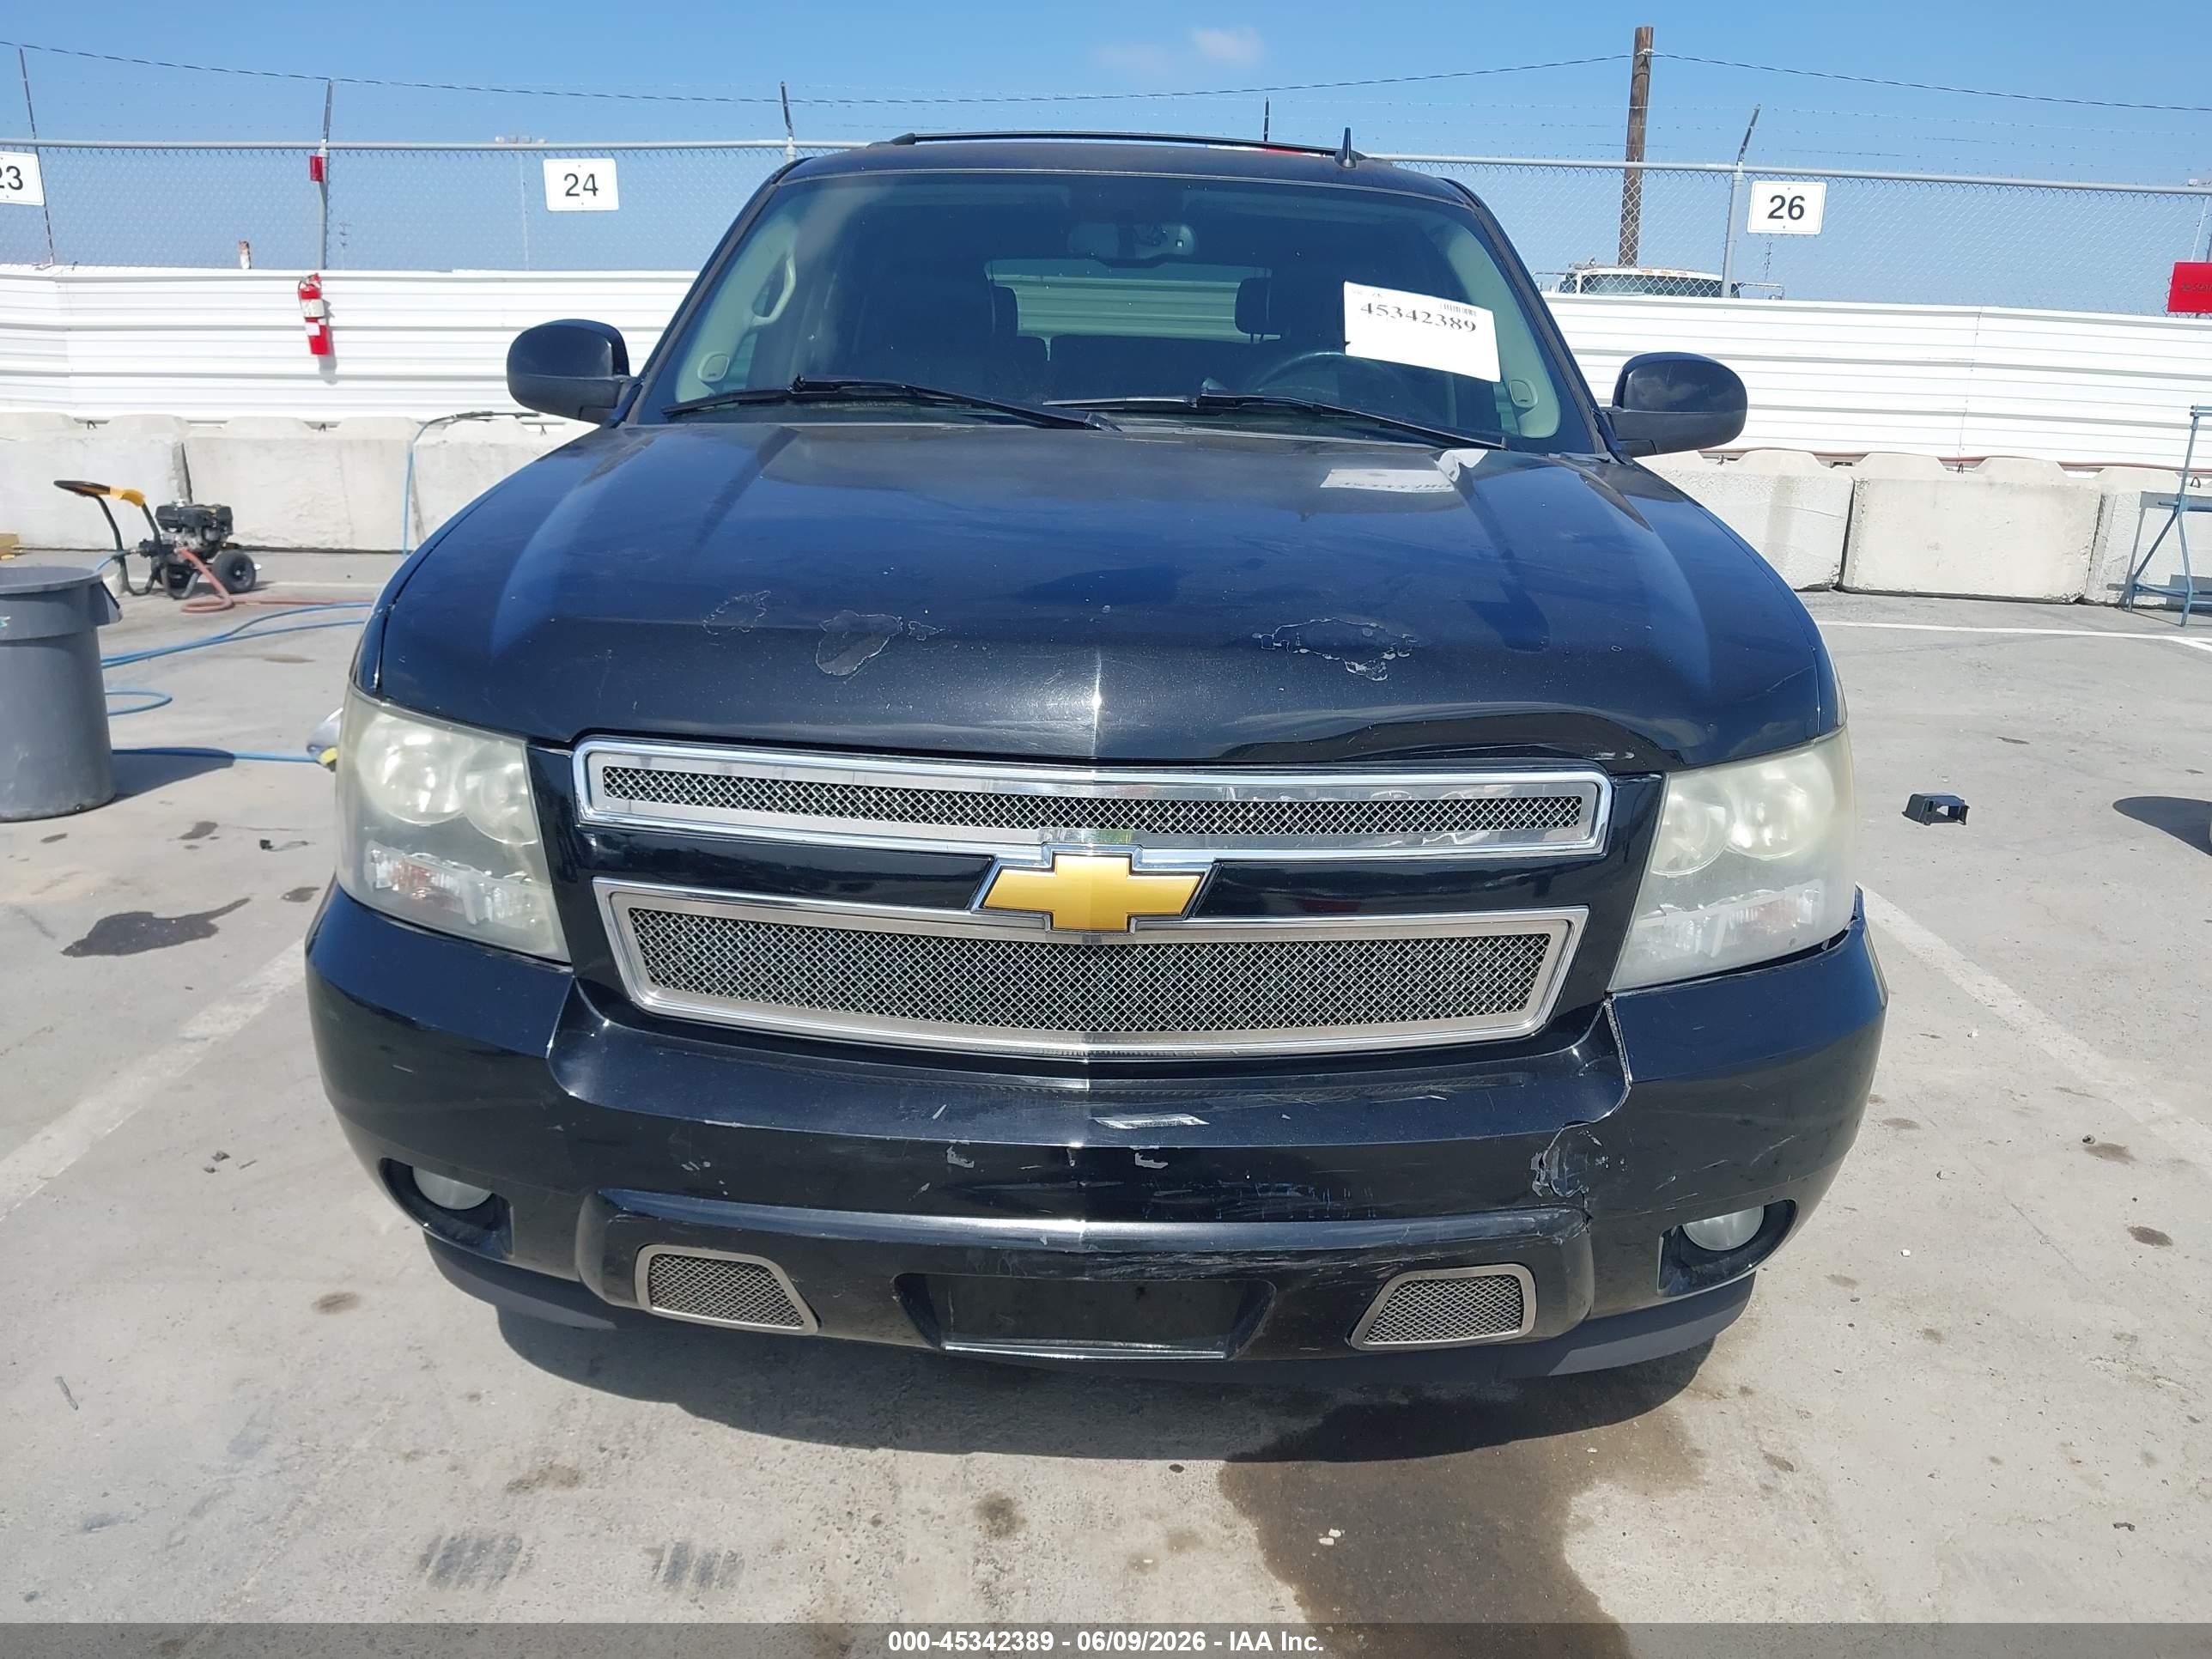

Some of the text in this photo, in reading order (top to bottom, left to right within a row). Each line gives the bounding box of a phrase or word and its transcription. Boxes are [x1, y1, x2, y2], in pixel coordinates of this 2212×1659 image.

[563, 173, 599, 197] 24
[1767, 194, 1805, 221] 26
[1359, 301, 1477, 333] 45342389
